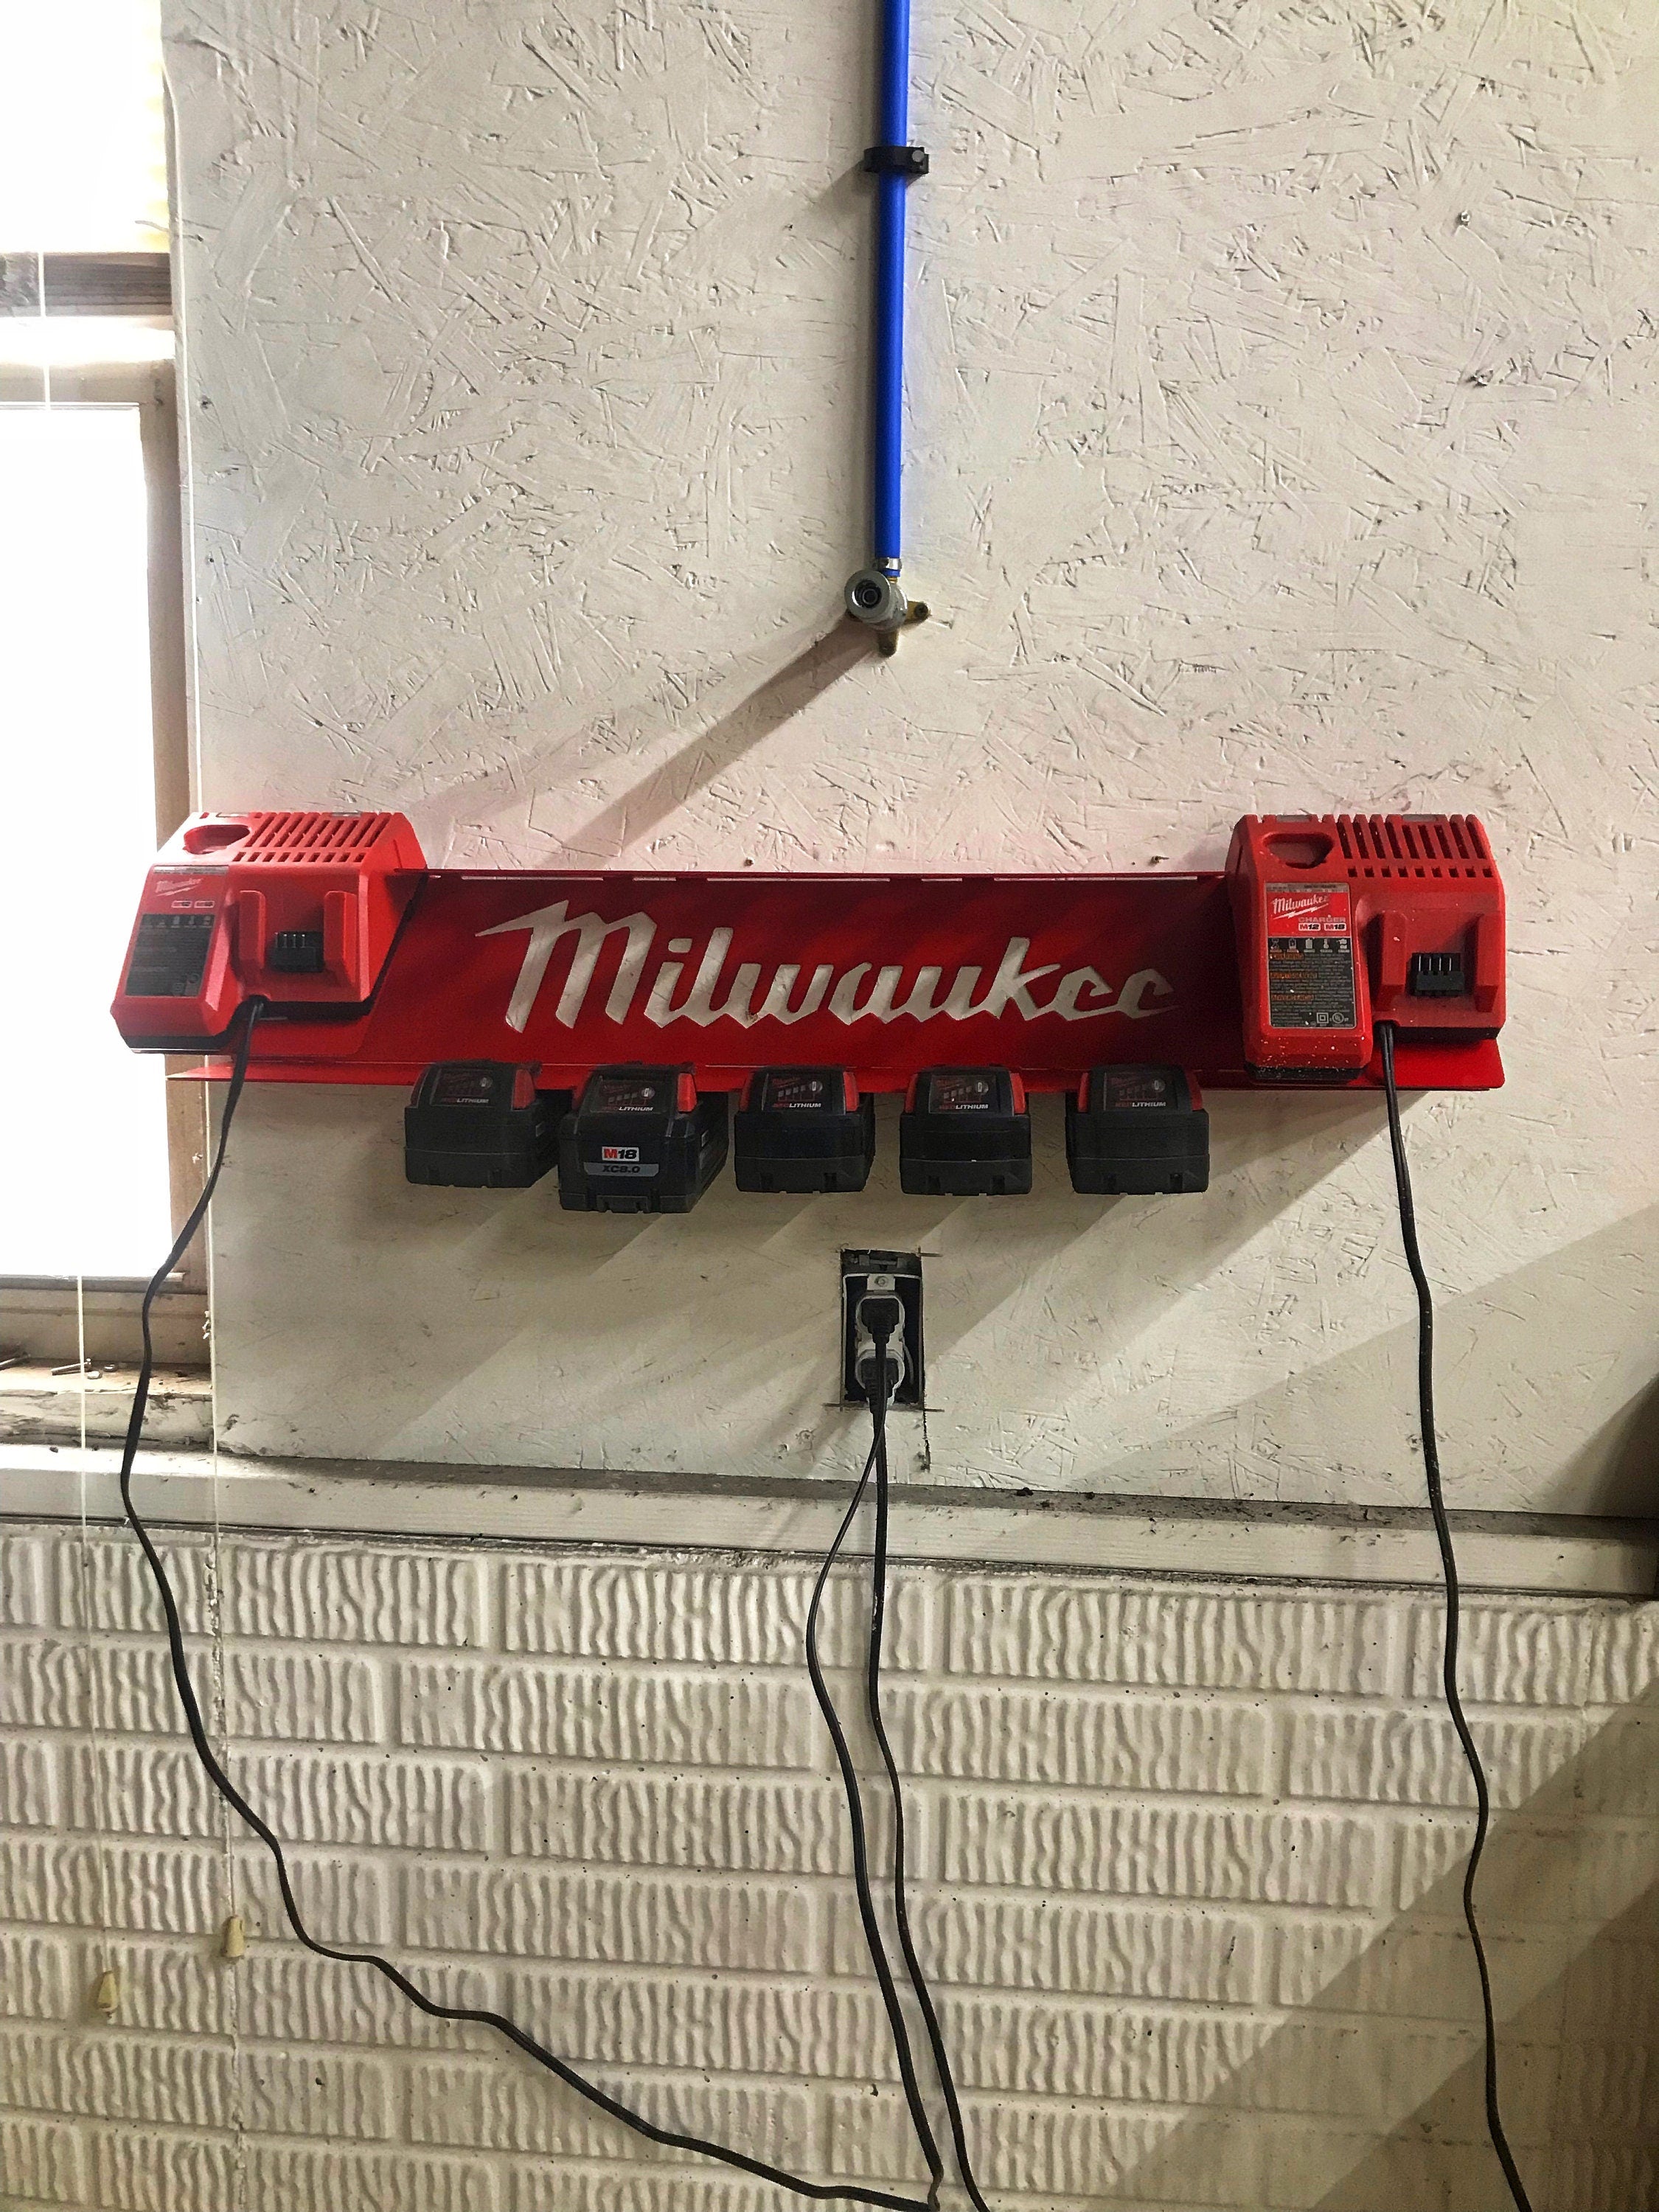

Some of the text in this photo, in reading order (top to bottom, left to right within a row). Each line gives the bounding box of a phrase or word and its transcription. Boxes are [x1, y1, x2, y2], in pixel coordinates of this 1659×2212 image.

[1270, 894, 1329, 915] Milwaukee
[476, 899, 1177, 1034] Milwaukee
[604, 1148, 638, 1159] M18
[602, 1165, 641, 1173] XC8.0
